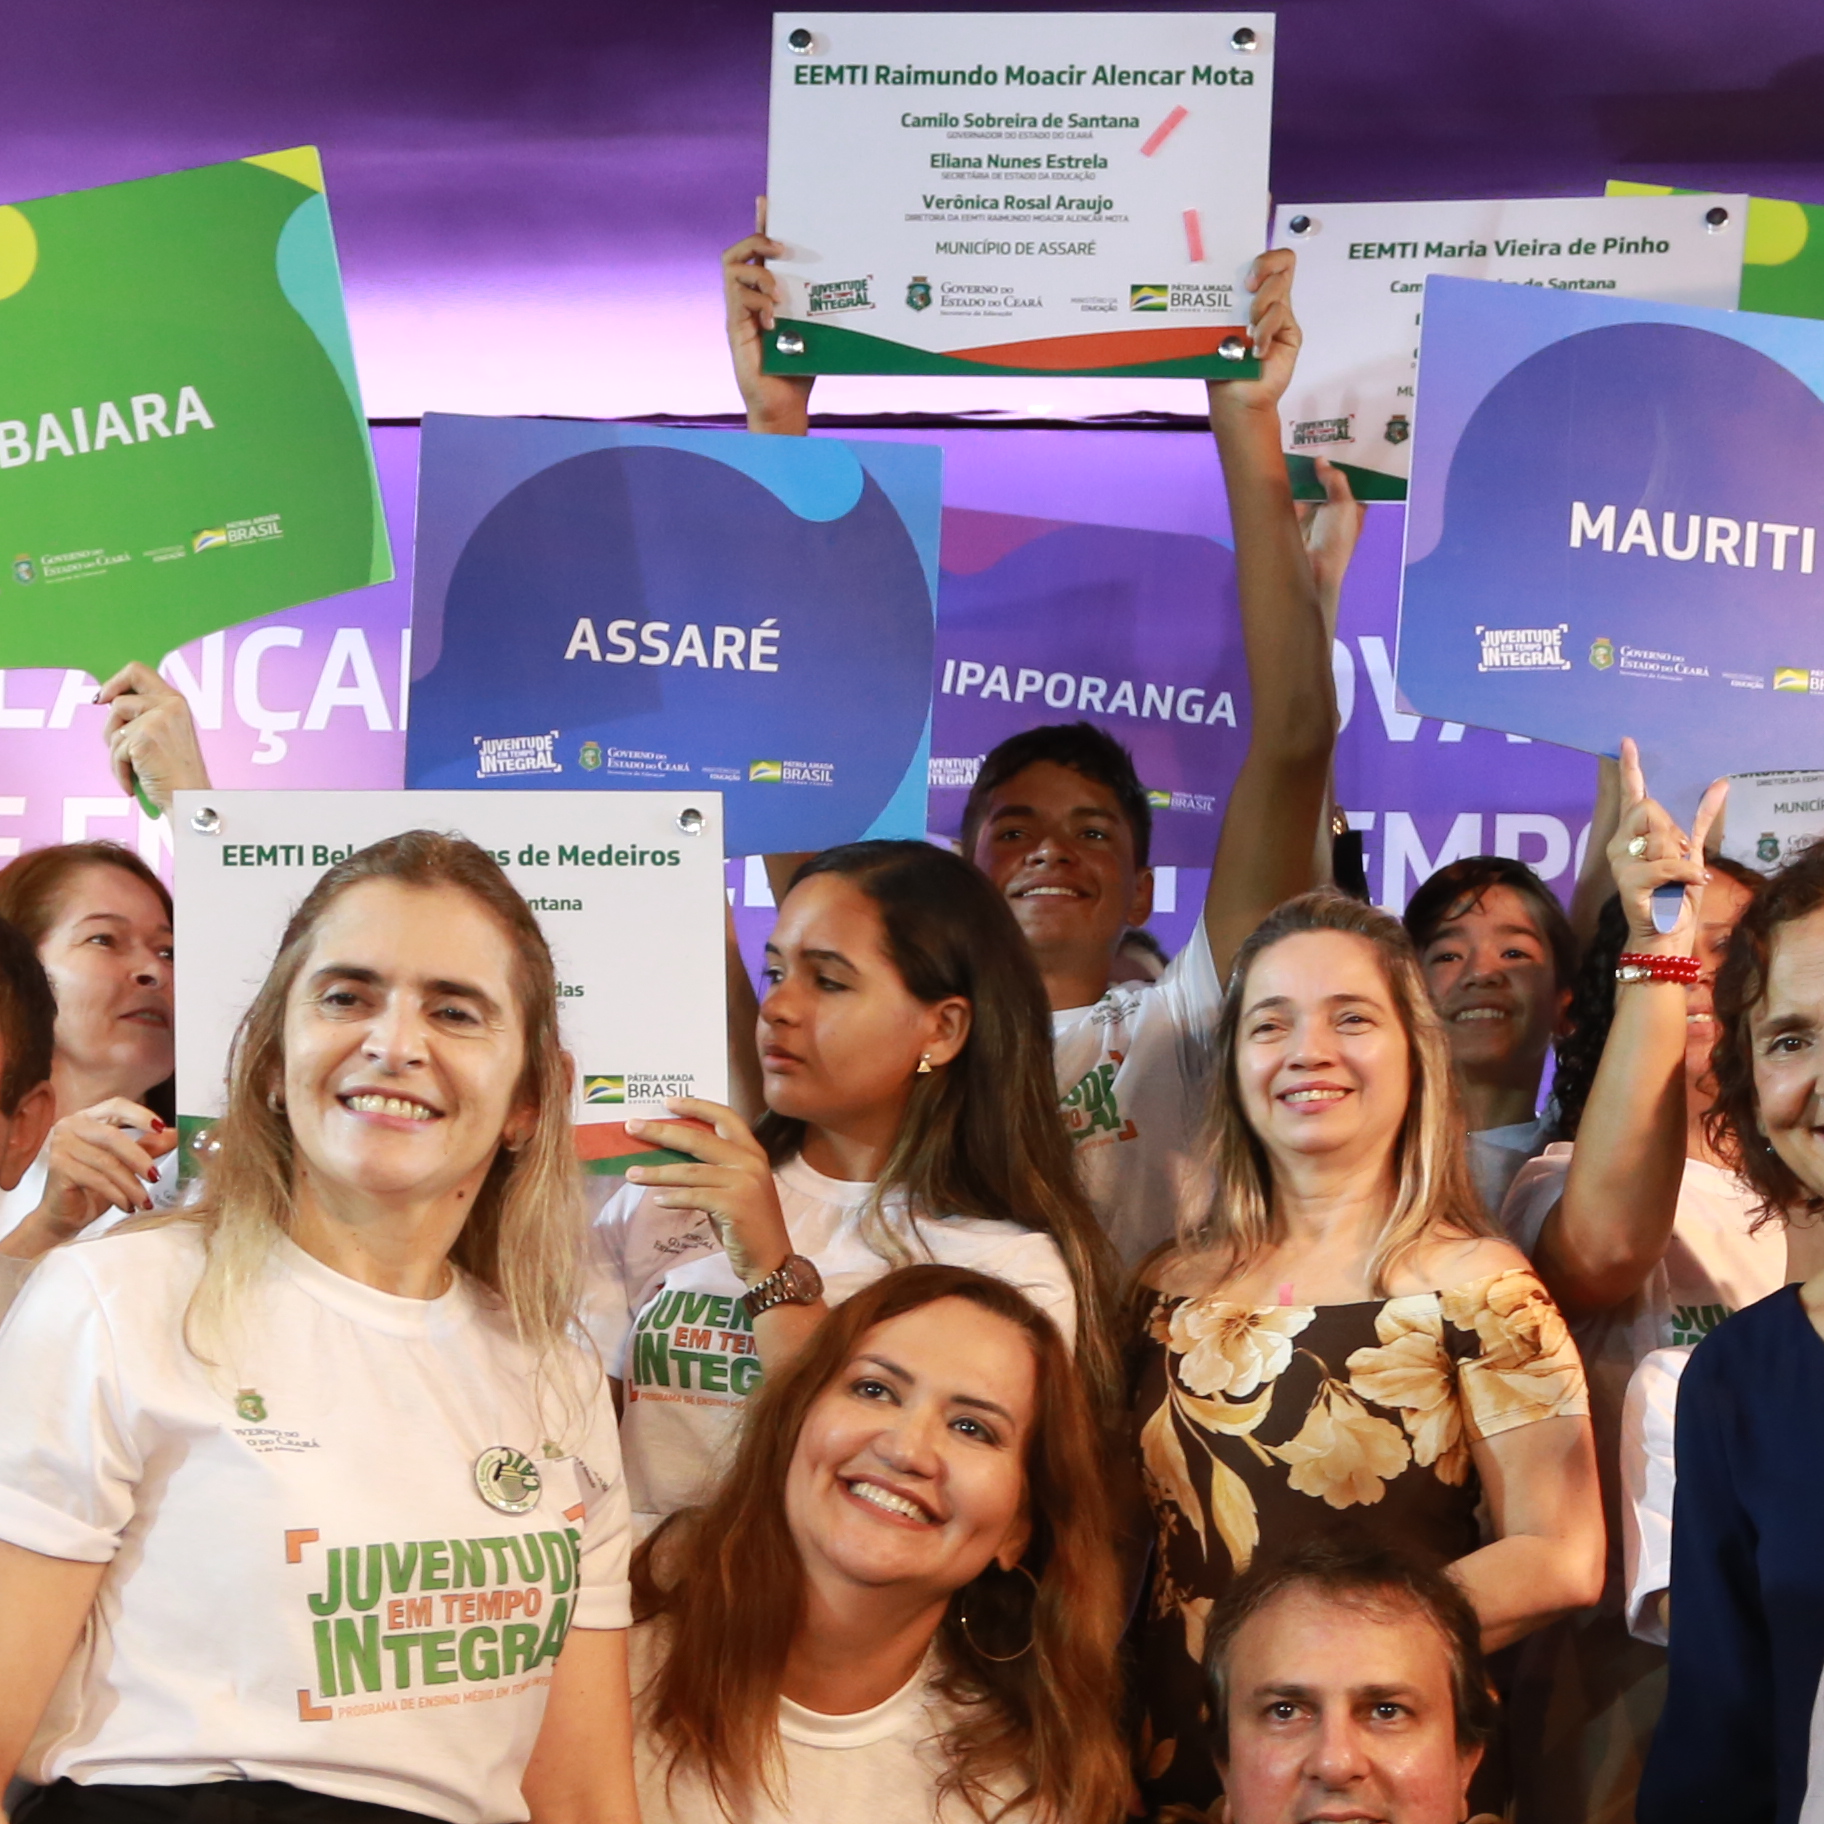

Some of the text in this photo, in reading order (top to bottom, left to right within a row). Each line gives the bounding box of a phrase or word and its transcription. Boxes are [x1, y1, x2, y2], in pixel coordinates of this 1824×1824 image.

[795, 64, 1254, 86] EEMTI Raimundo Moacir Alencar Mota
[922, 194, 1113, 215] Verônica Rosal Araujo
[936, 239, 1096, 255] MUNICÍPIO DE ASSARÉ
[1349, 236, 1669, 259] EEMTI Maria Vieira de Pinho
[1568, 500, 1816, 575] MAURITI
[563, 615, 781, 674] ASSARÉ
[941, 660, 1238, 728] IPAPORANGA
[222, 845, 305, 866] EEMTI
[518, 845, 550, 866] de
[558, 844, 680, 866] Medeiros
[387, 1587, 542, 1630] EM TEMPO
[313, 1597, 578, 1698] INTEGRA
